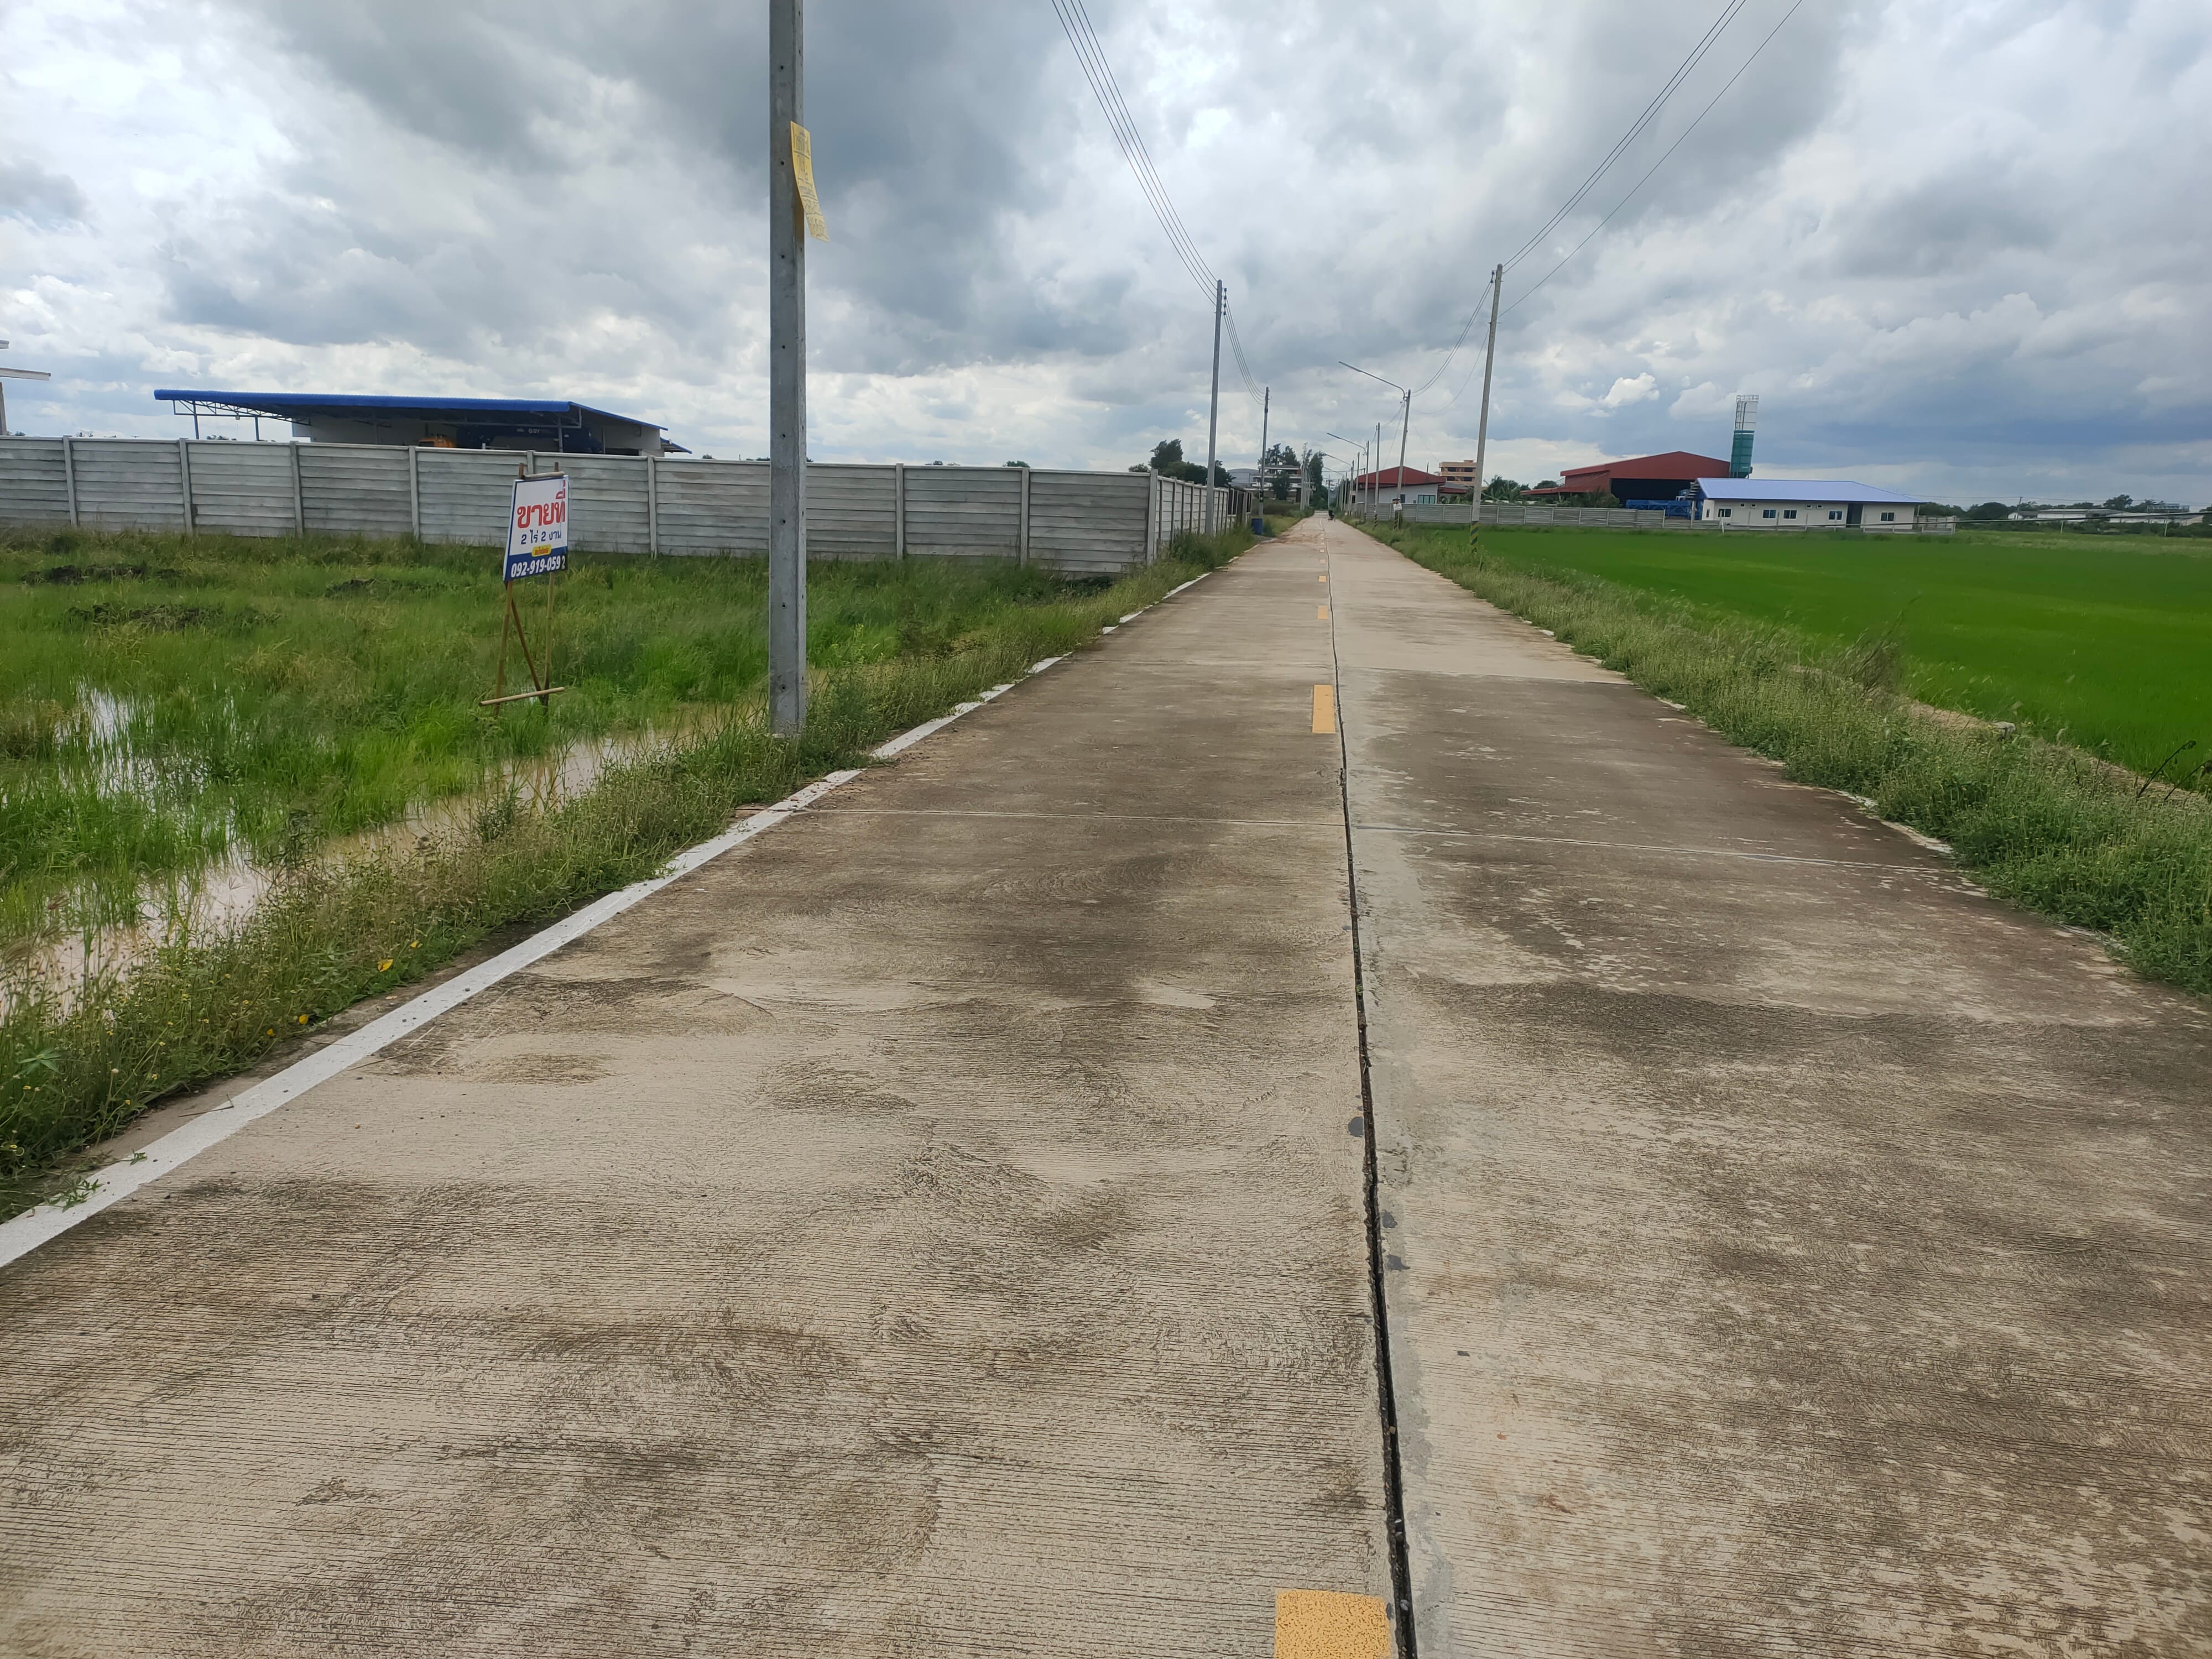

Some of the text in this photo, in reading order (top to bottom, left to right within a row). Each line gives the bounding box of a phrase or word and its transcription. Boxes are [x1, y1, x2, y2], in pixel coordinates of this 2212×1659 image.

[517, 480, 566, 528] ขายที่
[521, 529, 561, 545] 2 ไร่ 2 งาน
